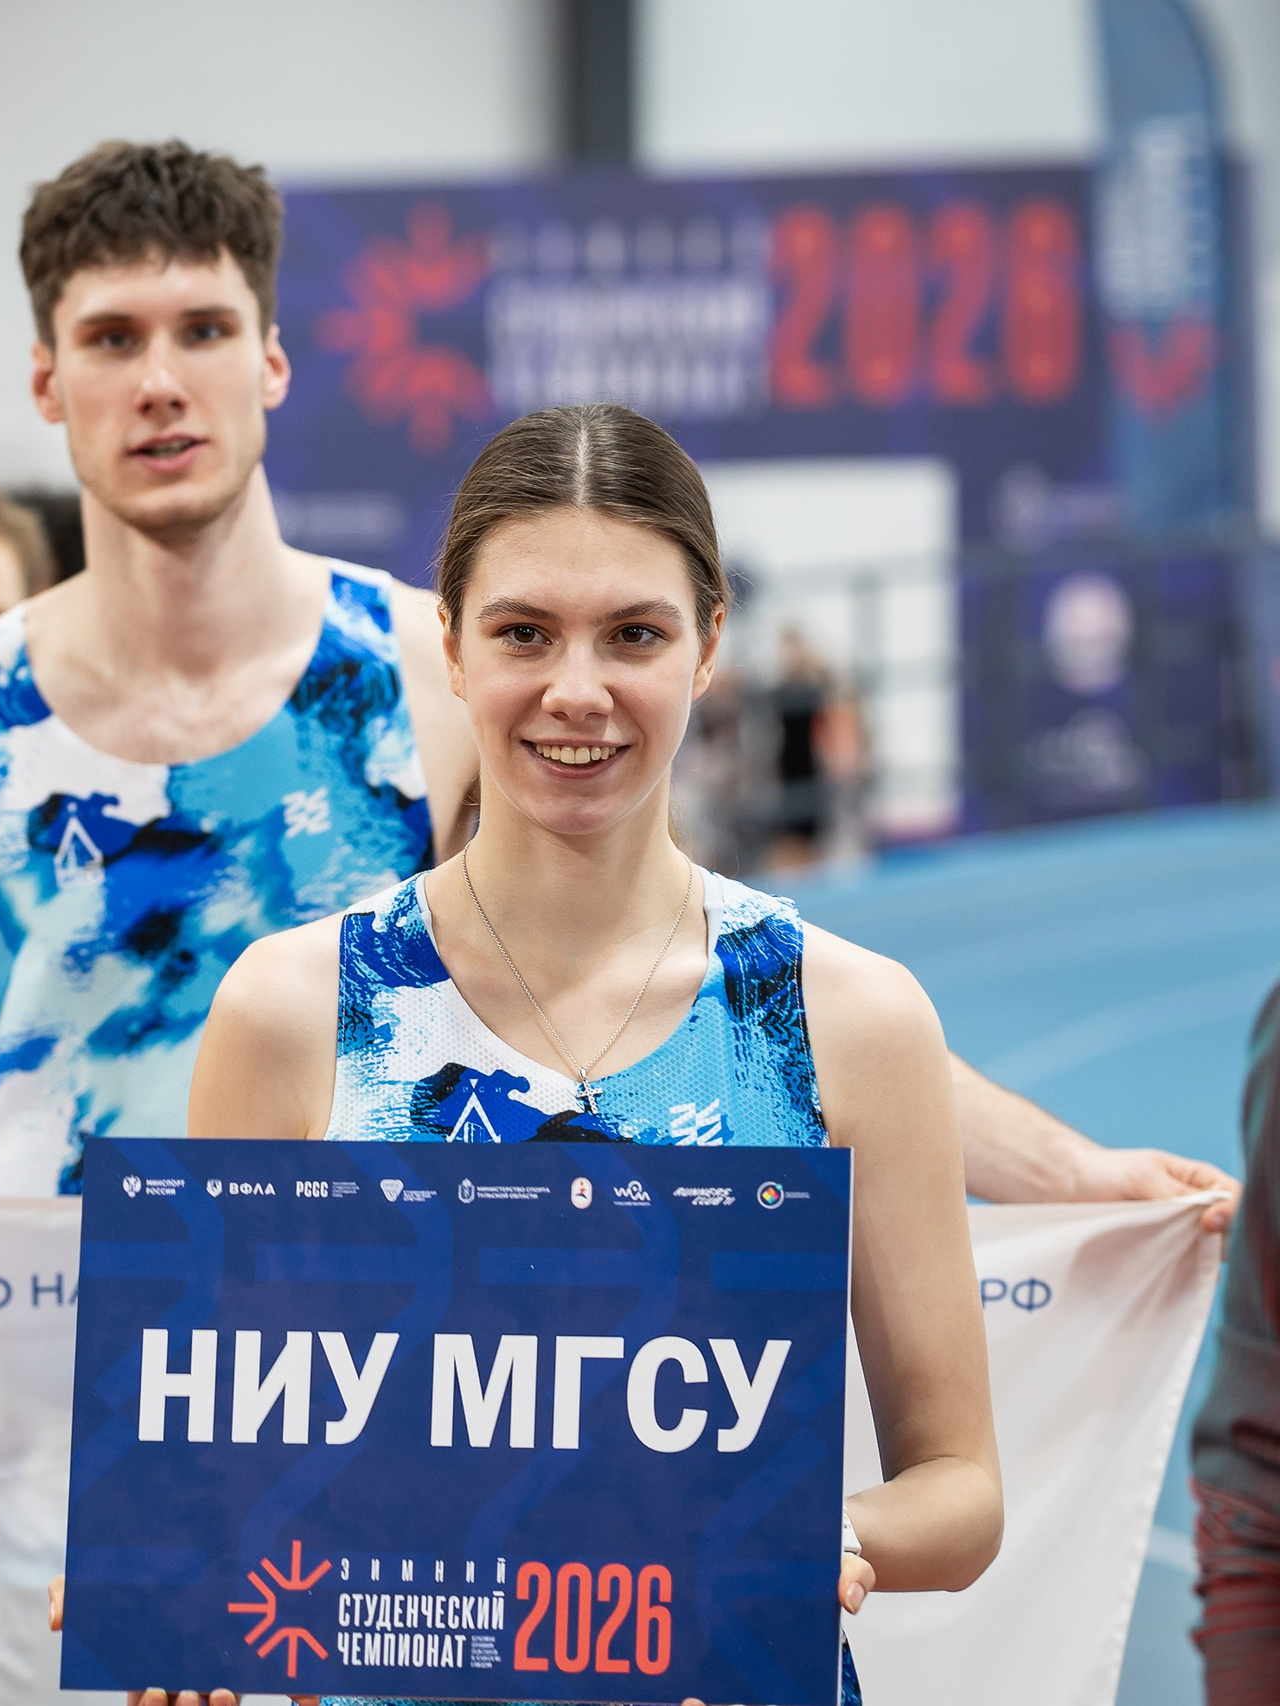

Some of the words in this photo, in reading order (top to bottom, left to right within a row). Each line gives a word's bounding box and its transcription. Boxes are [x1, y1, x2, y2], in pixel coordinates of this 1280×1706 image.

[770, 202, 1082, 404] 2026
[229, 1182, 276, 1196] ВФЛА
[980, 1276, 1053, 1313] РФ
[138, 1328, 400, 1445] НИУ
[430, 1332, 792, 1453] МГСУ
[340, 1557, 507, 1584] ЗИМНИЙ
[338, 1590, 506, 1631] СТУДЕНЧЕСКИЙ
[513, 1561, 673, 1675] 2026
[337, 1632, 467, 1668] ЧЕМПИОНАТ
